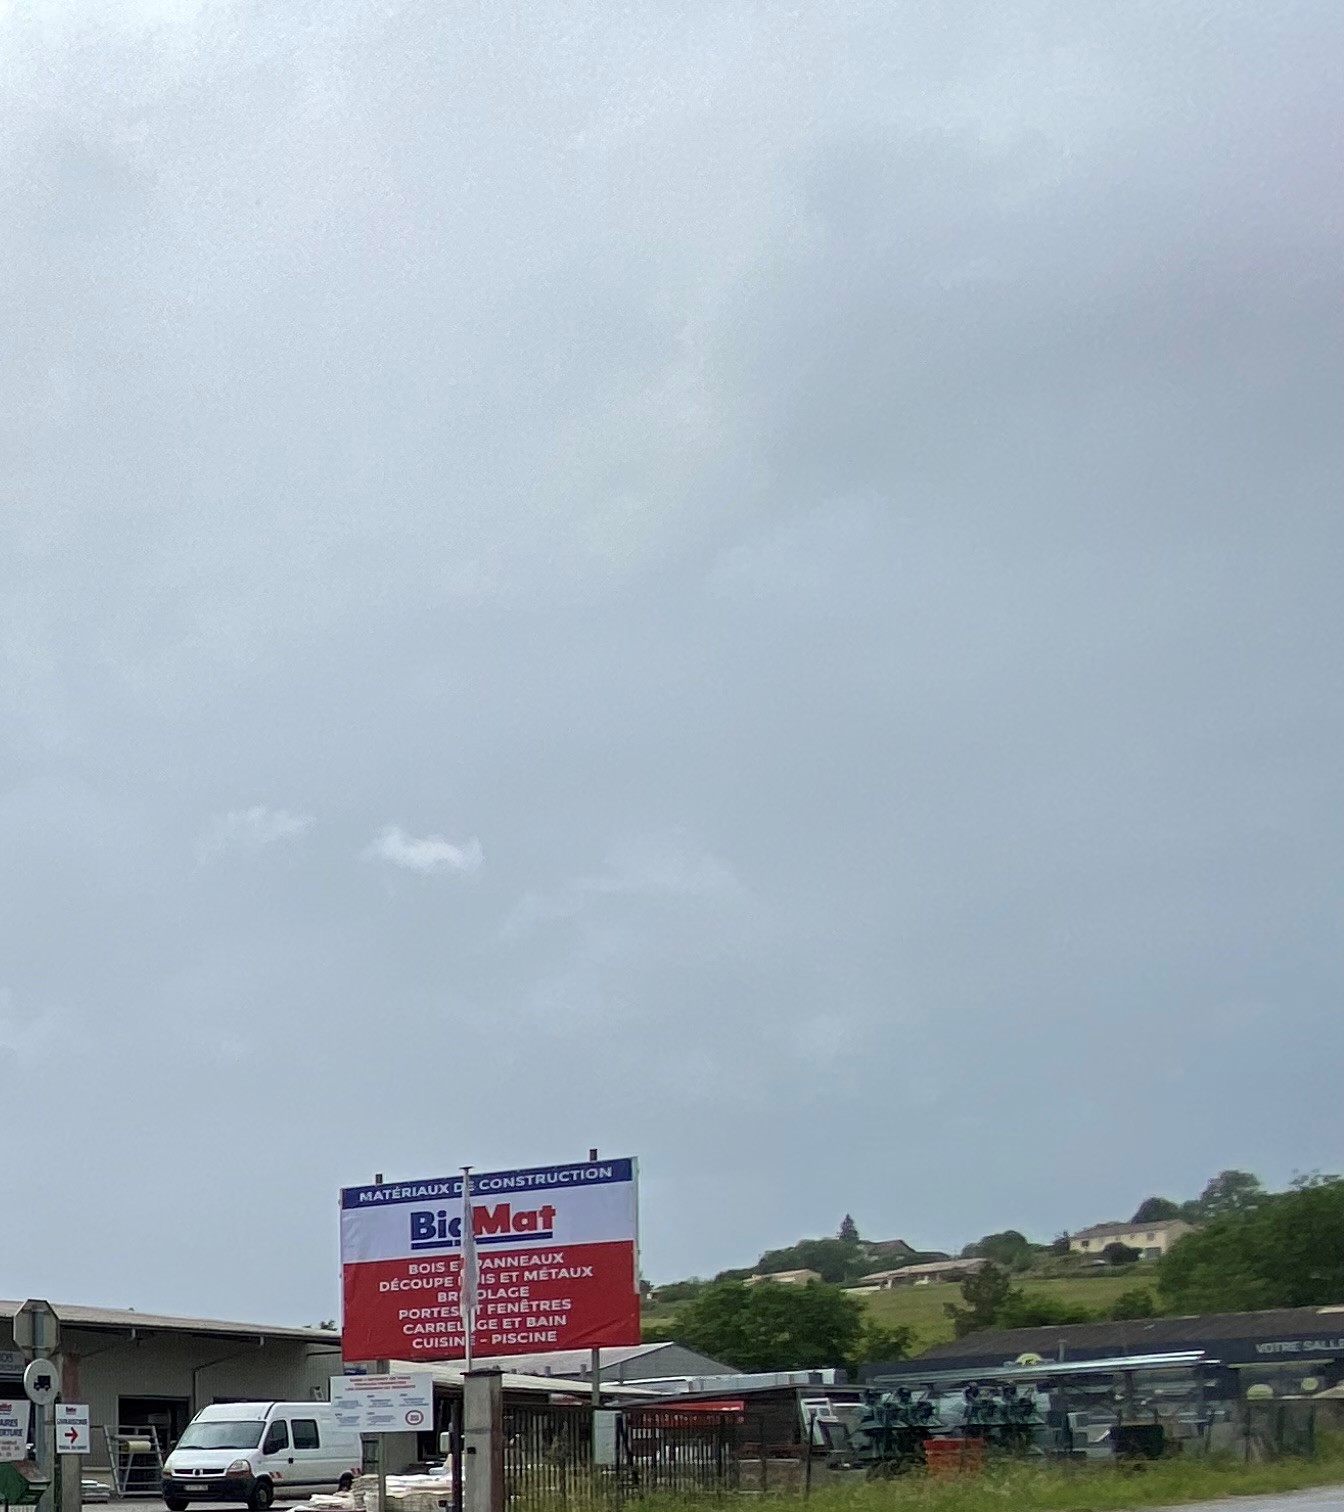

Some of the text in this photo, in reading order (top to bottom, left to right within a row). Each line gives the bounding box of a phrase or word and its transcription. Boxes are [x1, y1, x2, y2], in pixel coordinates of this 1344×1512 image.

[359, 1166, 612, 1202] MATÉRIAUX DE CONSTRUCTION
[409, 1262, 445, 1276] BOIS
[379, 1276, 453, 1292] DÉCOUPE
[500, 1271, 520, 1285] ET
[523, 1266, 594, 1282] MÉTAUX
[437, 1286, 530, 1303] BROLAGE
[398, 1305, 460, 1320] PORTES
[488, 1298, 572, 1314] FENÊTRES
[502, 1318, 521, 1329] ET
[526, 1314, 567, 1328] BAIN
[412, 1332, 476, 1348] CUISINE
[492, 1330, 558, 1345] PISCINE
[1255, 1341, 1300, 1353] VOTRE
